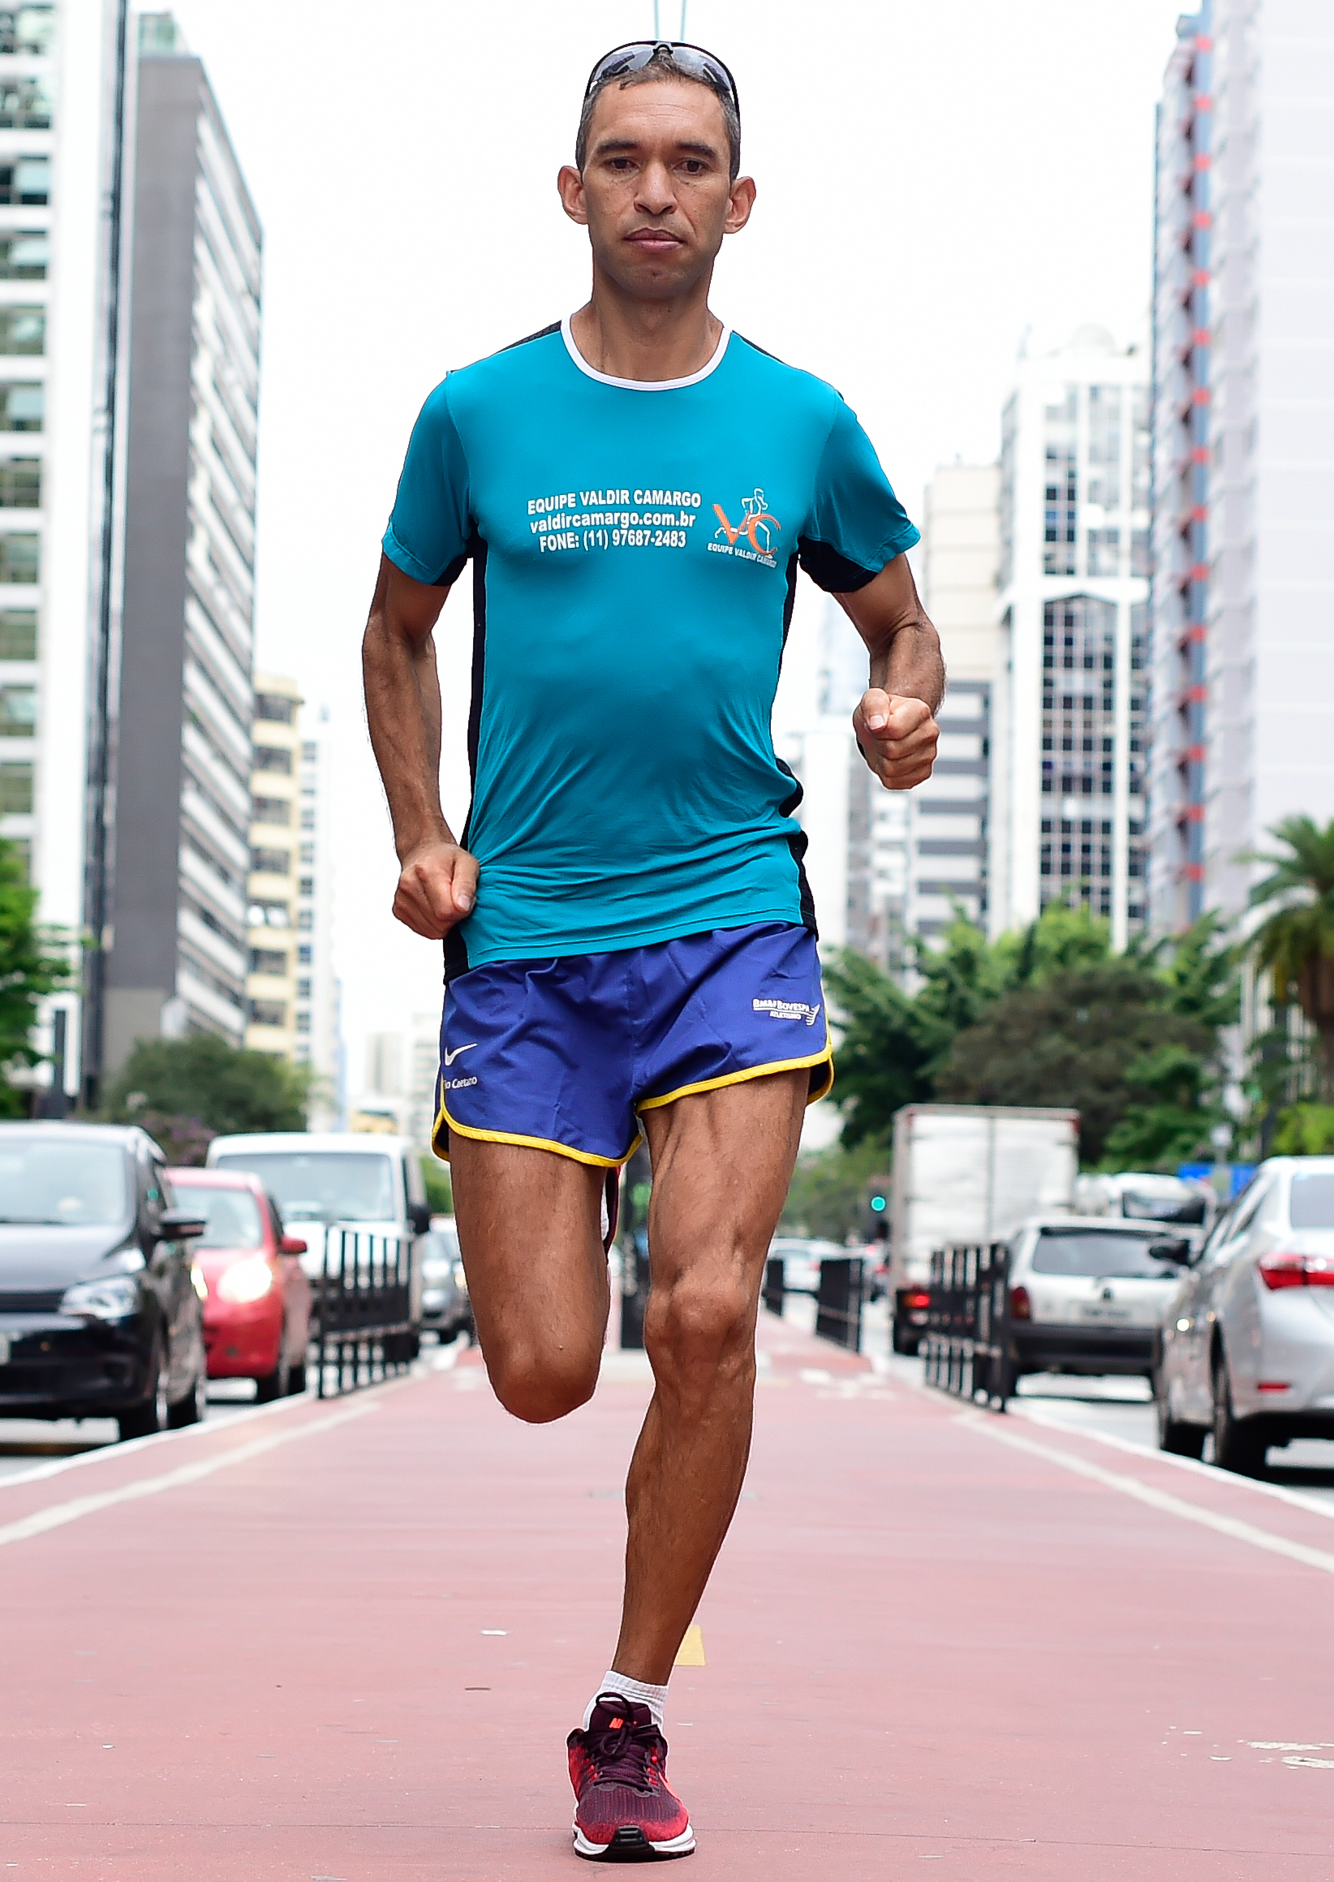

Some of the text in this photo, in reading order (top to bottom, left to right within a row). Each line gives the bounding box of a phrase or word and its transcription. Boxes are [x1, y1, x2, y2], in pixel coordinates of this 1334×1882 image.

[527, 489, 701, 515] EQUIPE VALDIR CAMARGO
[530, 510, 696, 534] valdircamargo.com.br
[539, 529, 686, 553] FONE: (11) 97687-2483
[707, 542, 734, 555] EQUIPE
